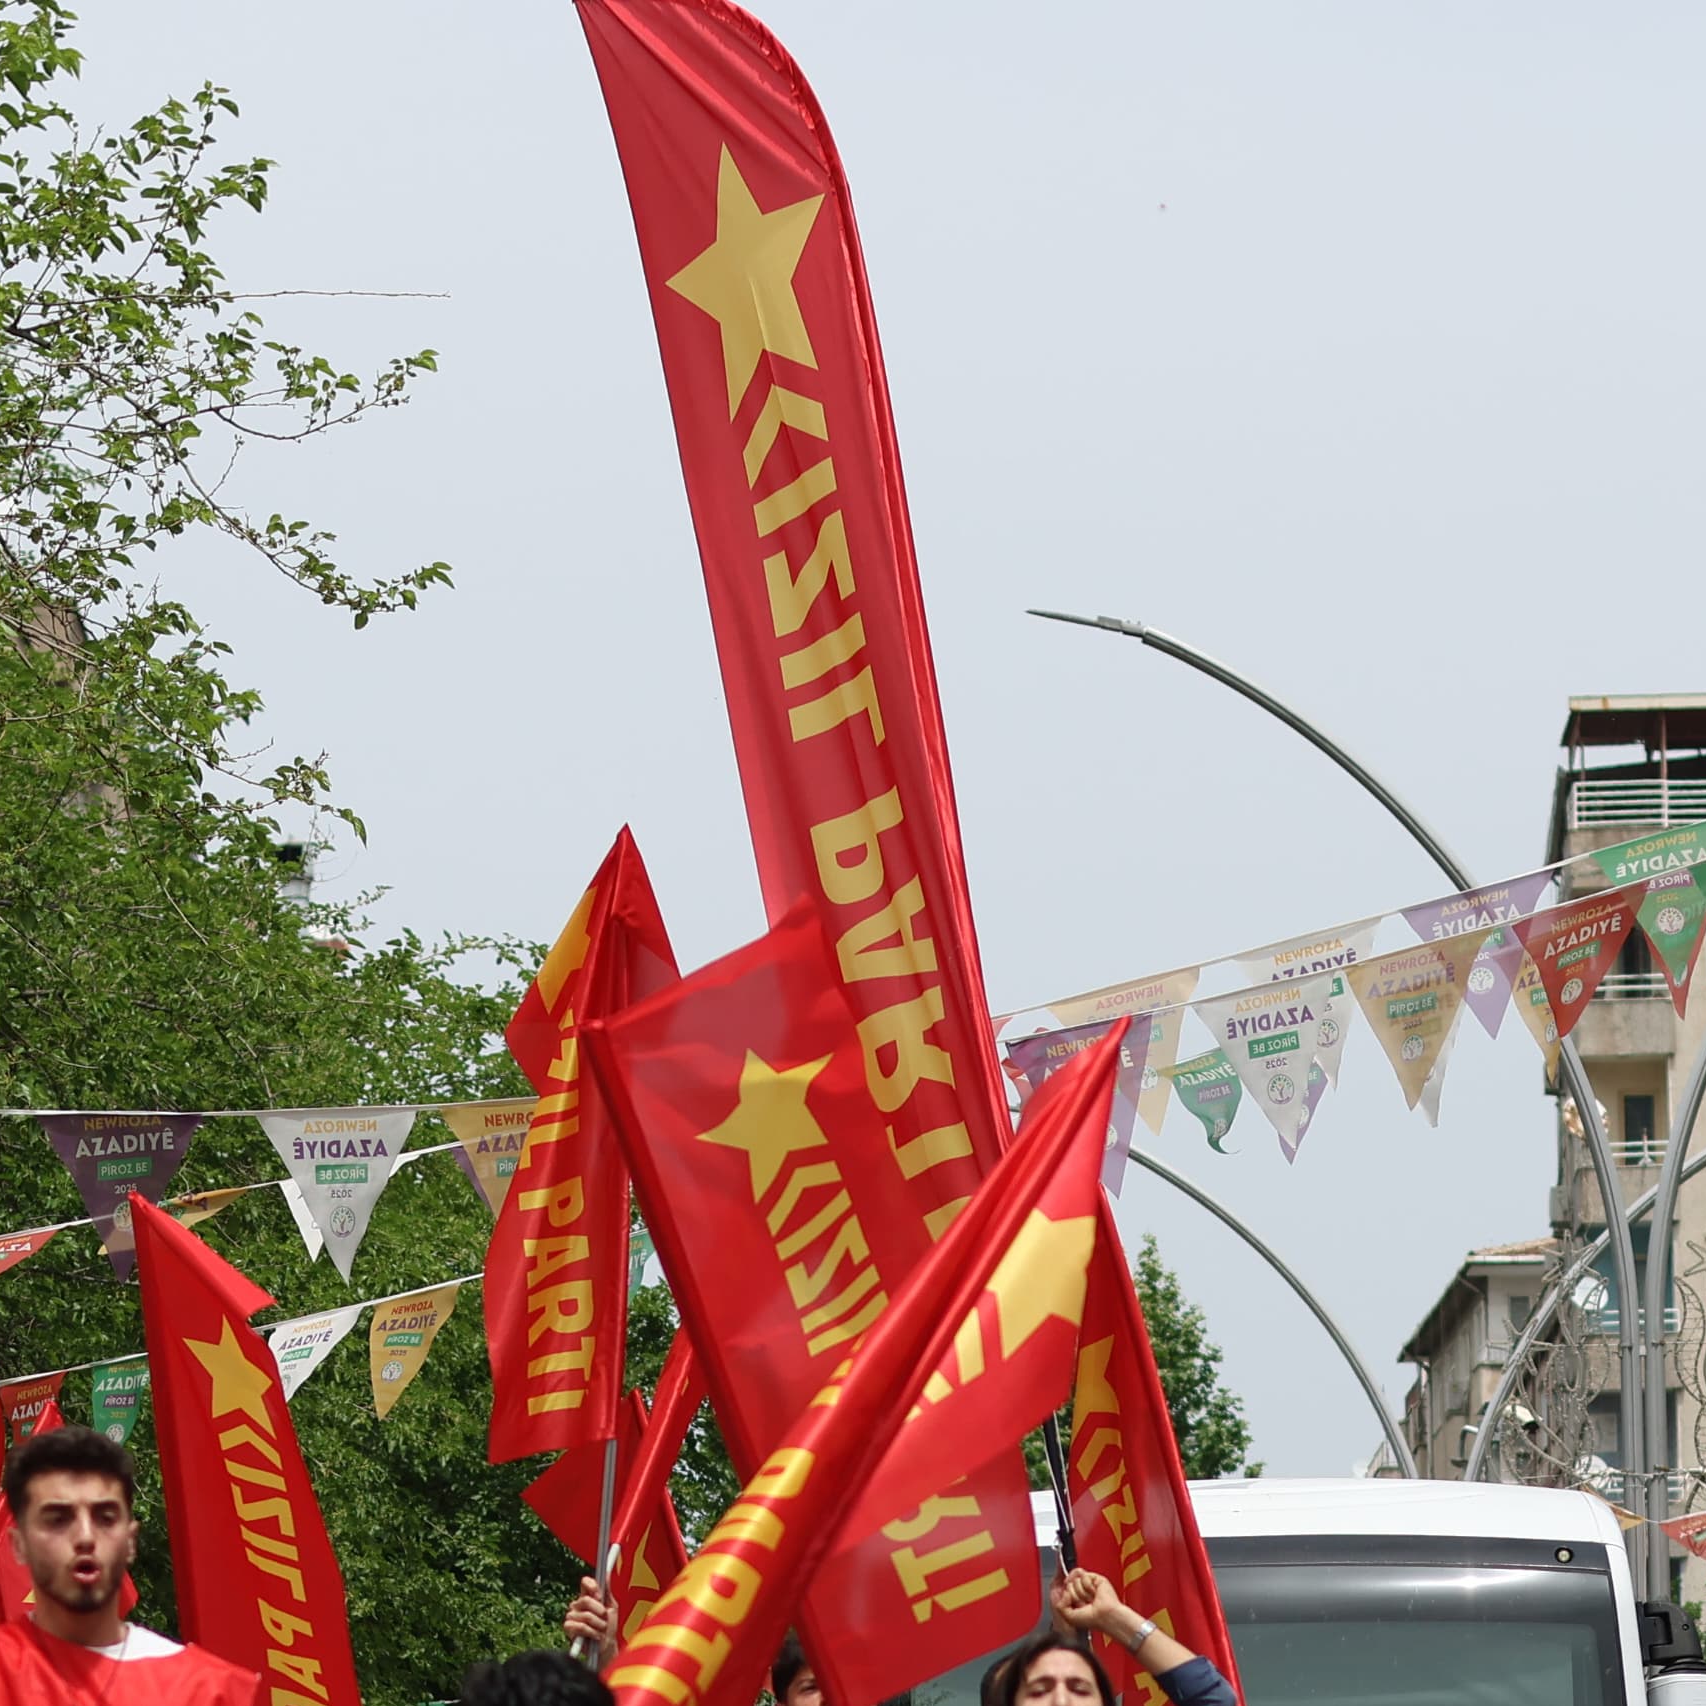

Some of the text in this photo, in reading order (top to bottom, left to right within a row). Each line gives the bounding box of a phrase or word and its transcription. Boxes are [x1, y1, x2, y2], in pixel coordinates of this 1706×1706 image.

[1551, 903, 1613, 935] NEWROZA
[1544, 912, 1623, 960] AZADIYÊ
[1274, 938, 1343, 966] NEWROZA
[1380, 951, 1446, 976] NEWROZA
[1367, 962, 1456, 998] AZADIYÊ
[84, 1116, 162, 1131] NEWROZA
[75, 1128, 175, 1159] AZADIYÊ
[135, 1161, 149, 1173] BE
[391, 1300, 434, 1316] NEWROZA
[376, 1311, 438, 1332] AZADIYÊ
[278, 1328, 334, 1352] AZADIYÊ
